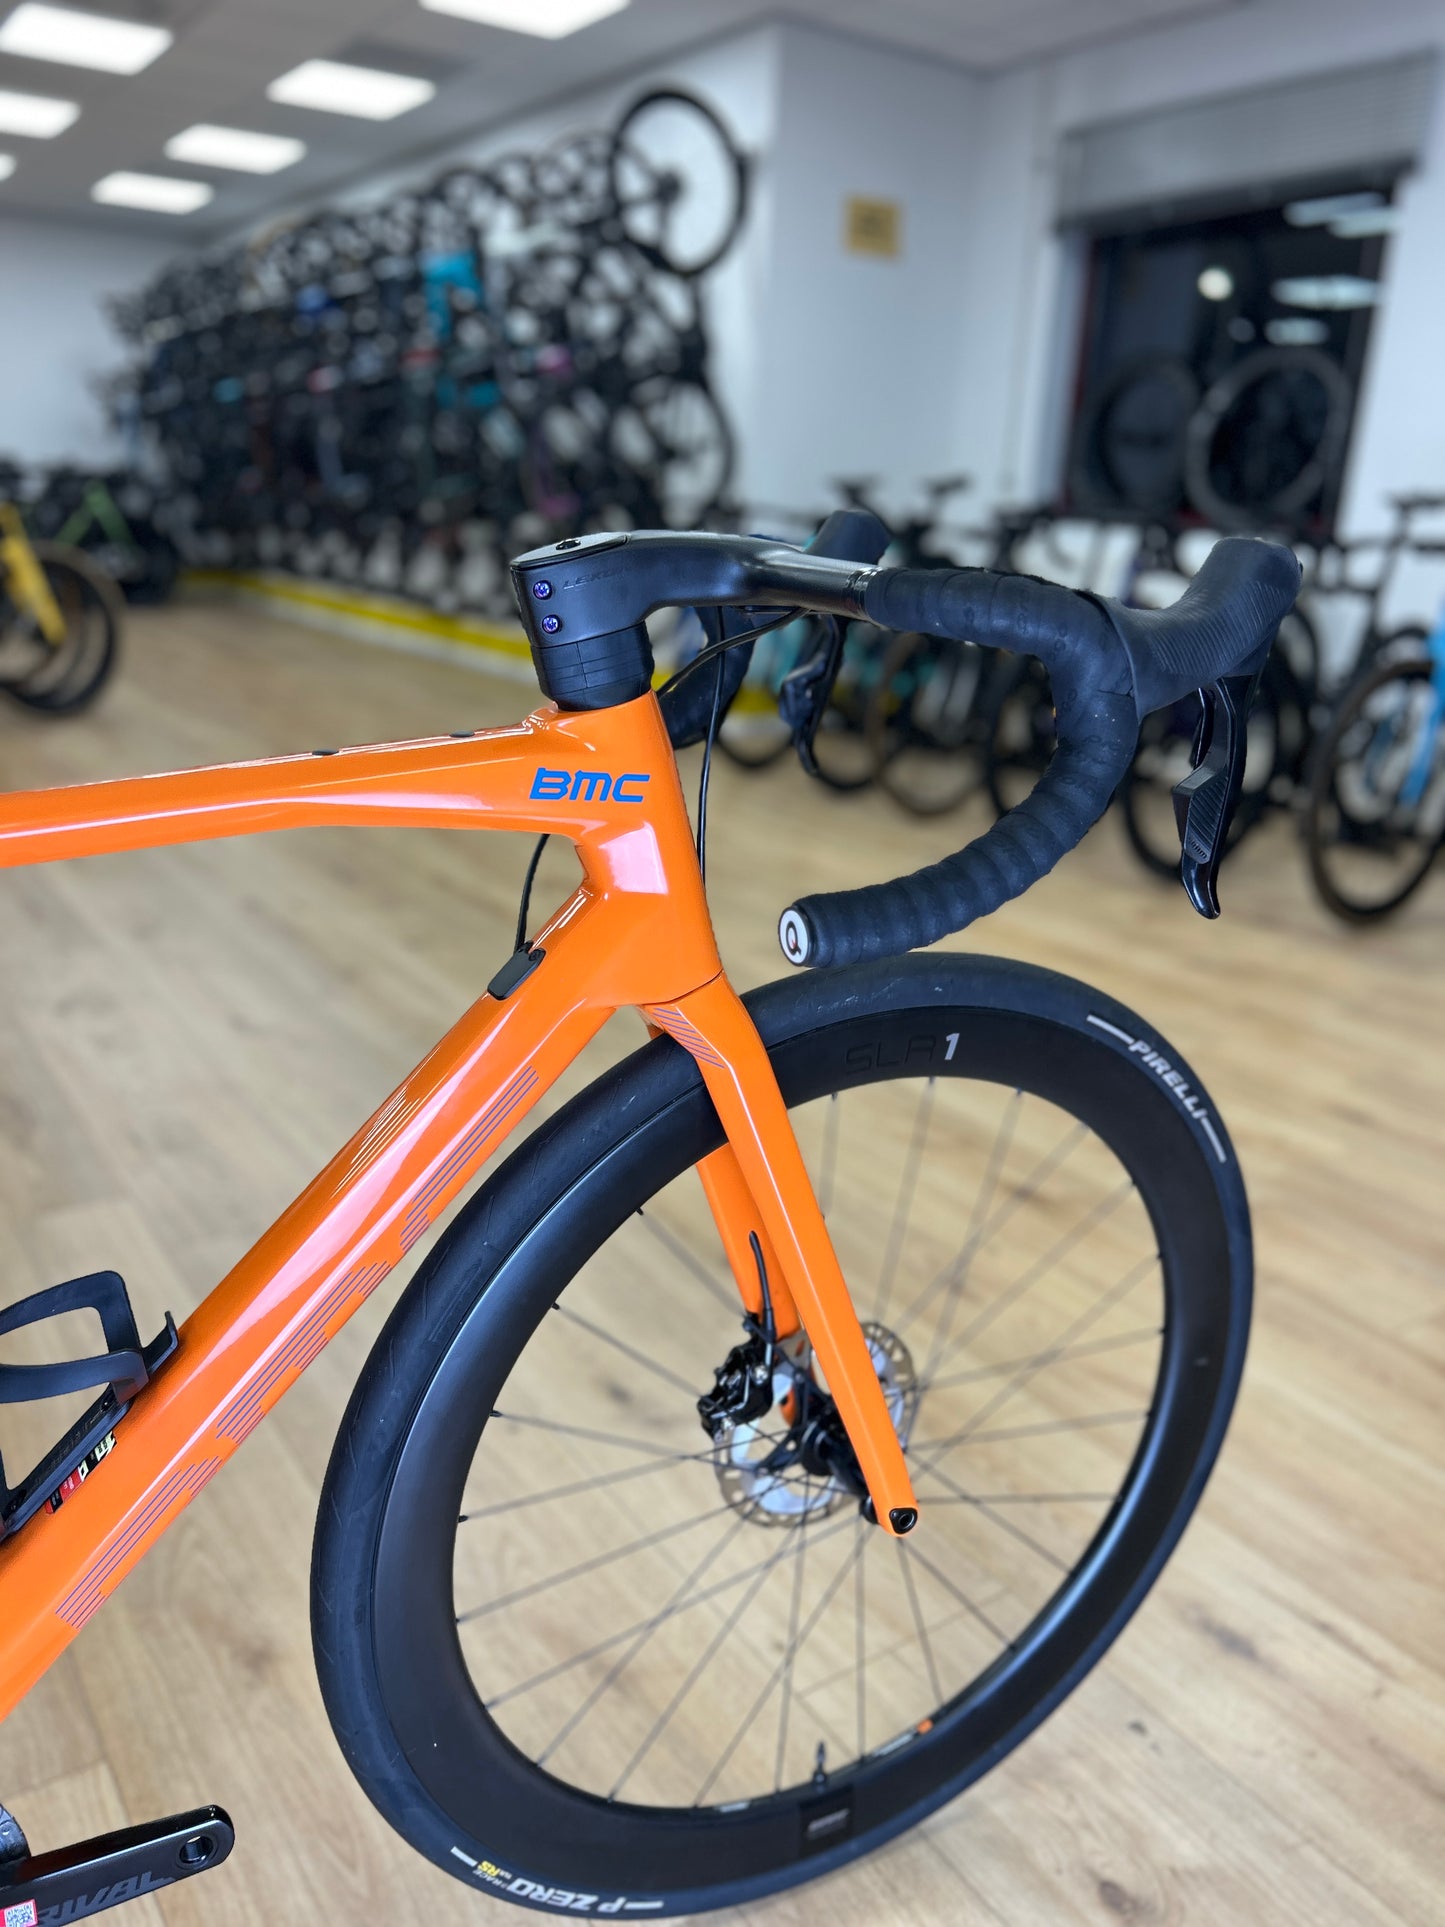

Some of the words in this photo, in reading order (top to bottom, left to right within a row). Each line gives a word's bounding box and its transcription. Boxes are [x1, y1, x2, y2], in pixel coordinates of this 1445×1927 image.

[529, 767, 650, 803] BMC
[786, 920, 802, 956] Q
[1128, 1040, 1208, 1120] PIRELLI
[477, 1860, 501, 1877] RS
[507, 1877, 599, 1911] ZERO
[597, 1897, 627, 1914] P
